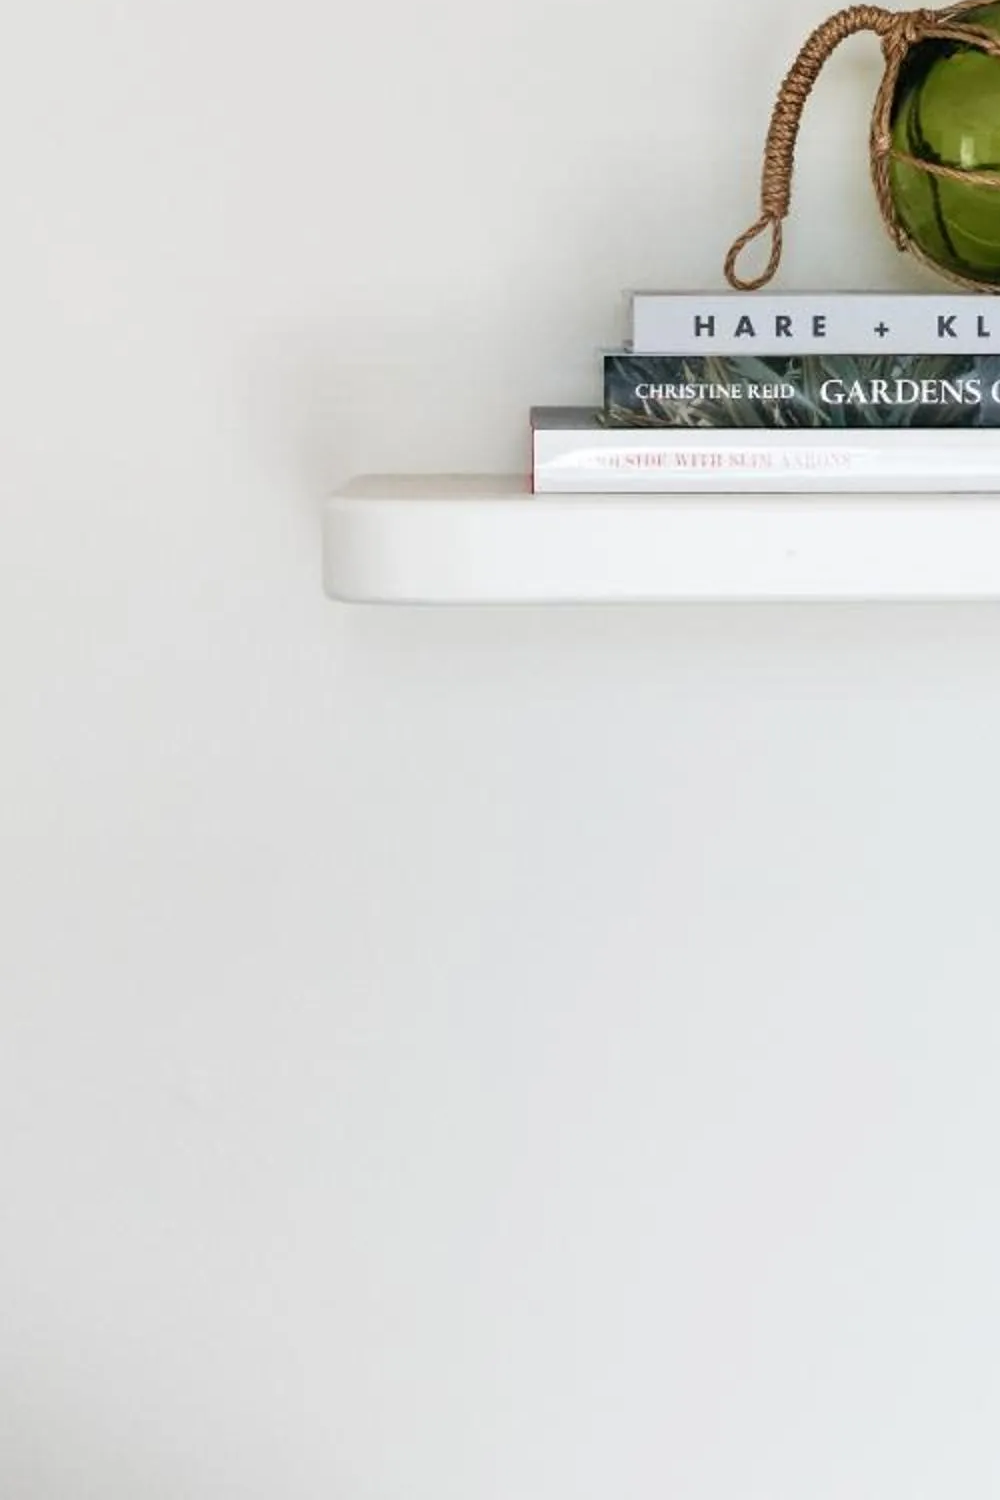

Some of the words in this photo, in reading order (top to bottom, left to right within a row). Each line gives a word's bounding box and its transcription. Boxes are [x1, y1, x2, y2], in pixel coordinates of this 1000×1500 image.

[694, 315, 826, 338] HARE
[873, 321, 890, 338] +
[635, 383, 742, 399] CHRISTINE
[748, 383, 795, 399] REID
[820, 378, 981, 404] GARDENS
[674, 451, 724, 468] WITH
